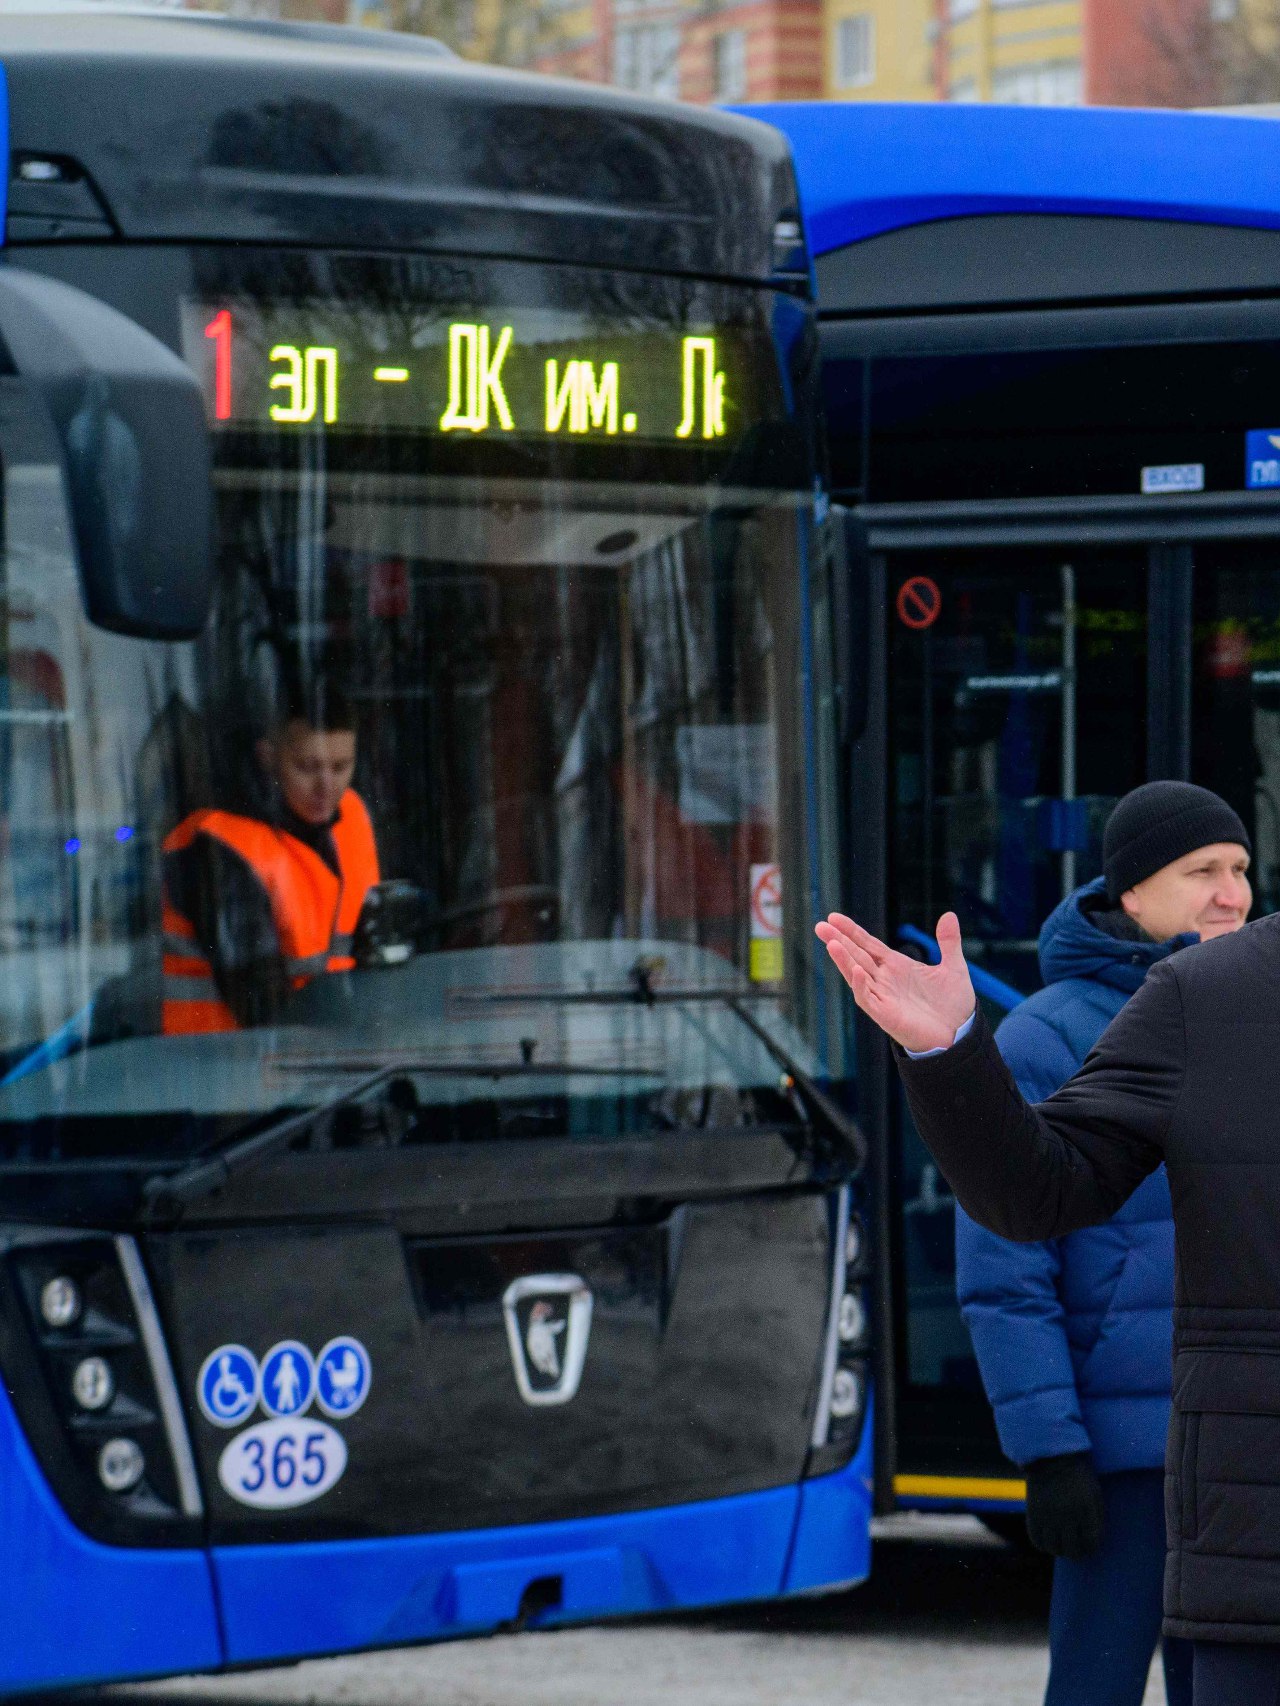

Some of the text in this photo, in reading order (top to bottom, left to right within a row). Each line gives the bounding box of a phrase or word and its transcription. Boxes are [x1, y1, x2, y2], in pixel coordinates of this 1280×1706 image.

[205, 310, 231, 419] 1
[441, 323, 514, 432] ДК
[546, 359, 638, 434] им.
[242, 1434, 326, 1492] 365
